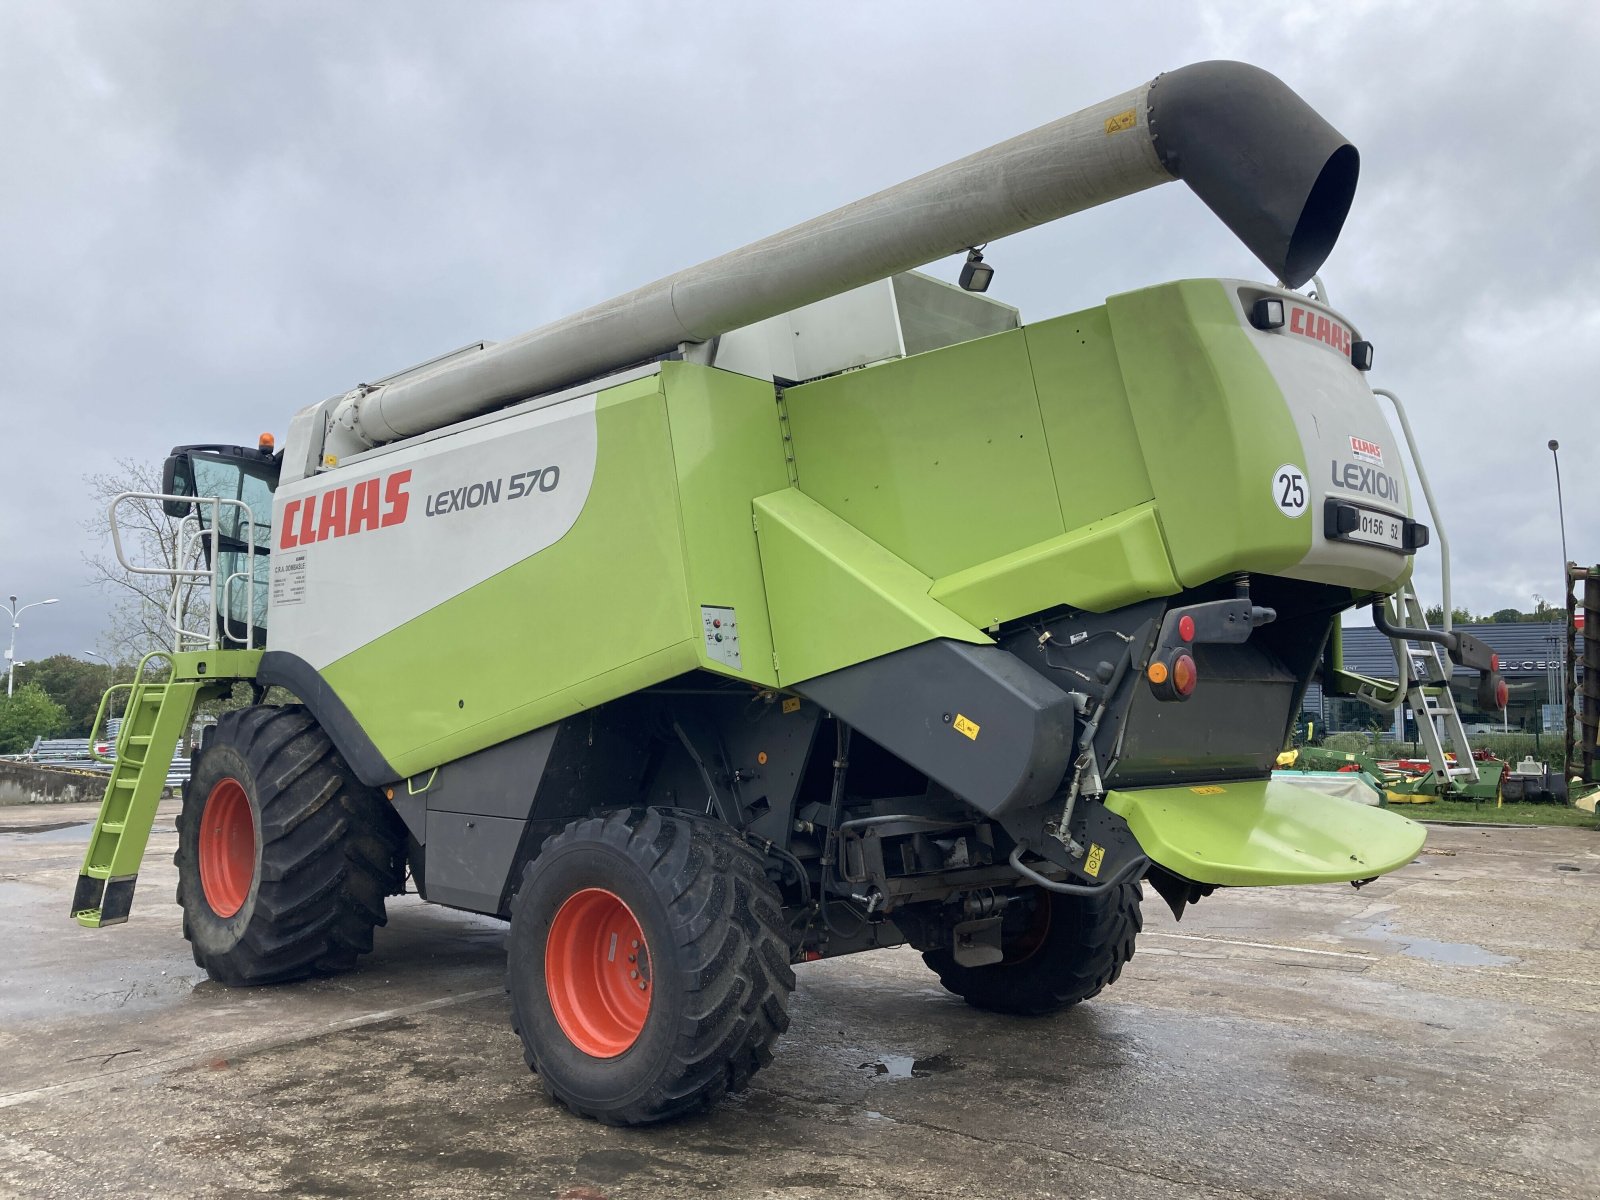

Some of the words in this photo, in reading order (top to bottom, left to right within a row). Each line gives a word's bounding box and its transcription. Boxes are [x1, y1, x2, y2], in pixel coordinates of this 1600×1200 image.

[1290, 307, 1350, 357] CLAAS
[1352, 437, 1380, 458] CLAAS
[426, 478, 502, 517] LEXION
[507, 466, 560, 500] 570
[1279, 473, 1305, 508] 25
[1331, 460, 1399, 503] LEXION
[280, 469, 412, 549] CLAAS
[1390, 523, 1398, 540] 52
